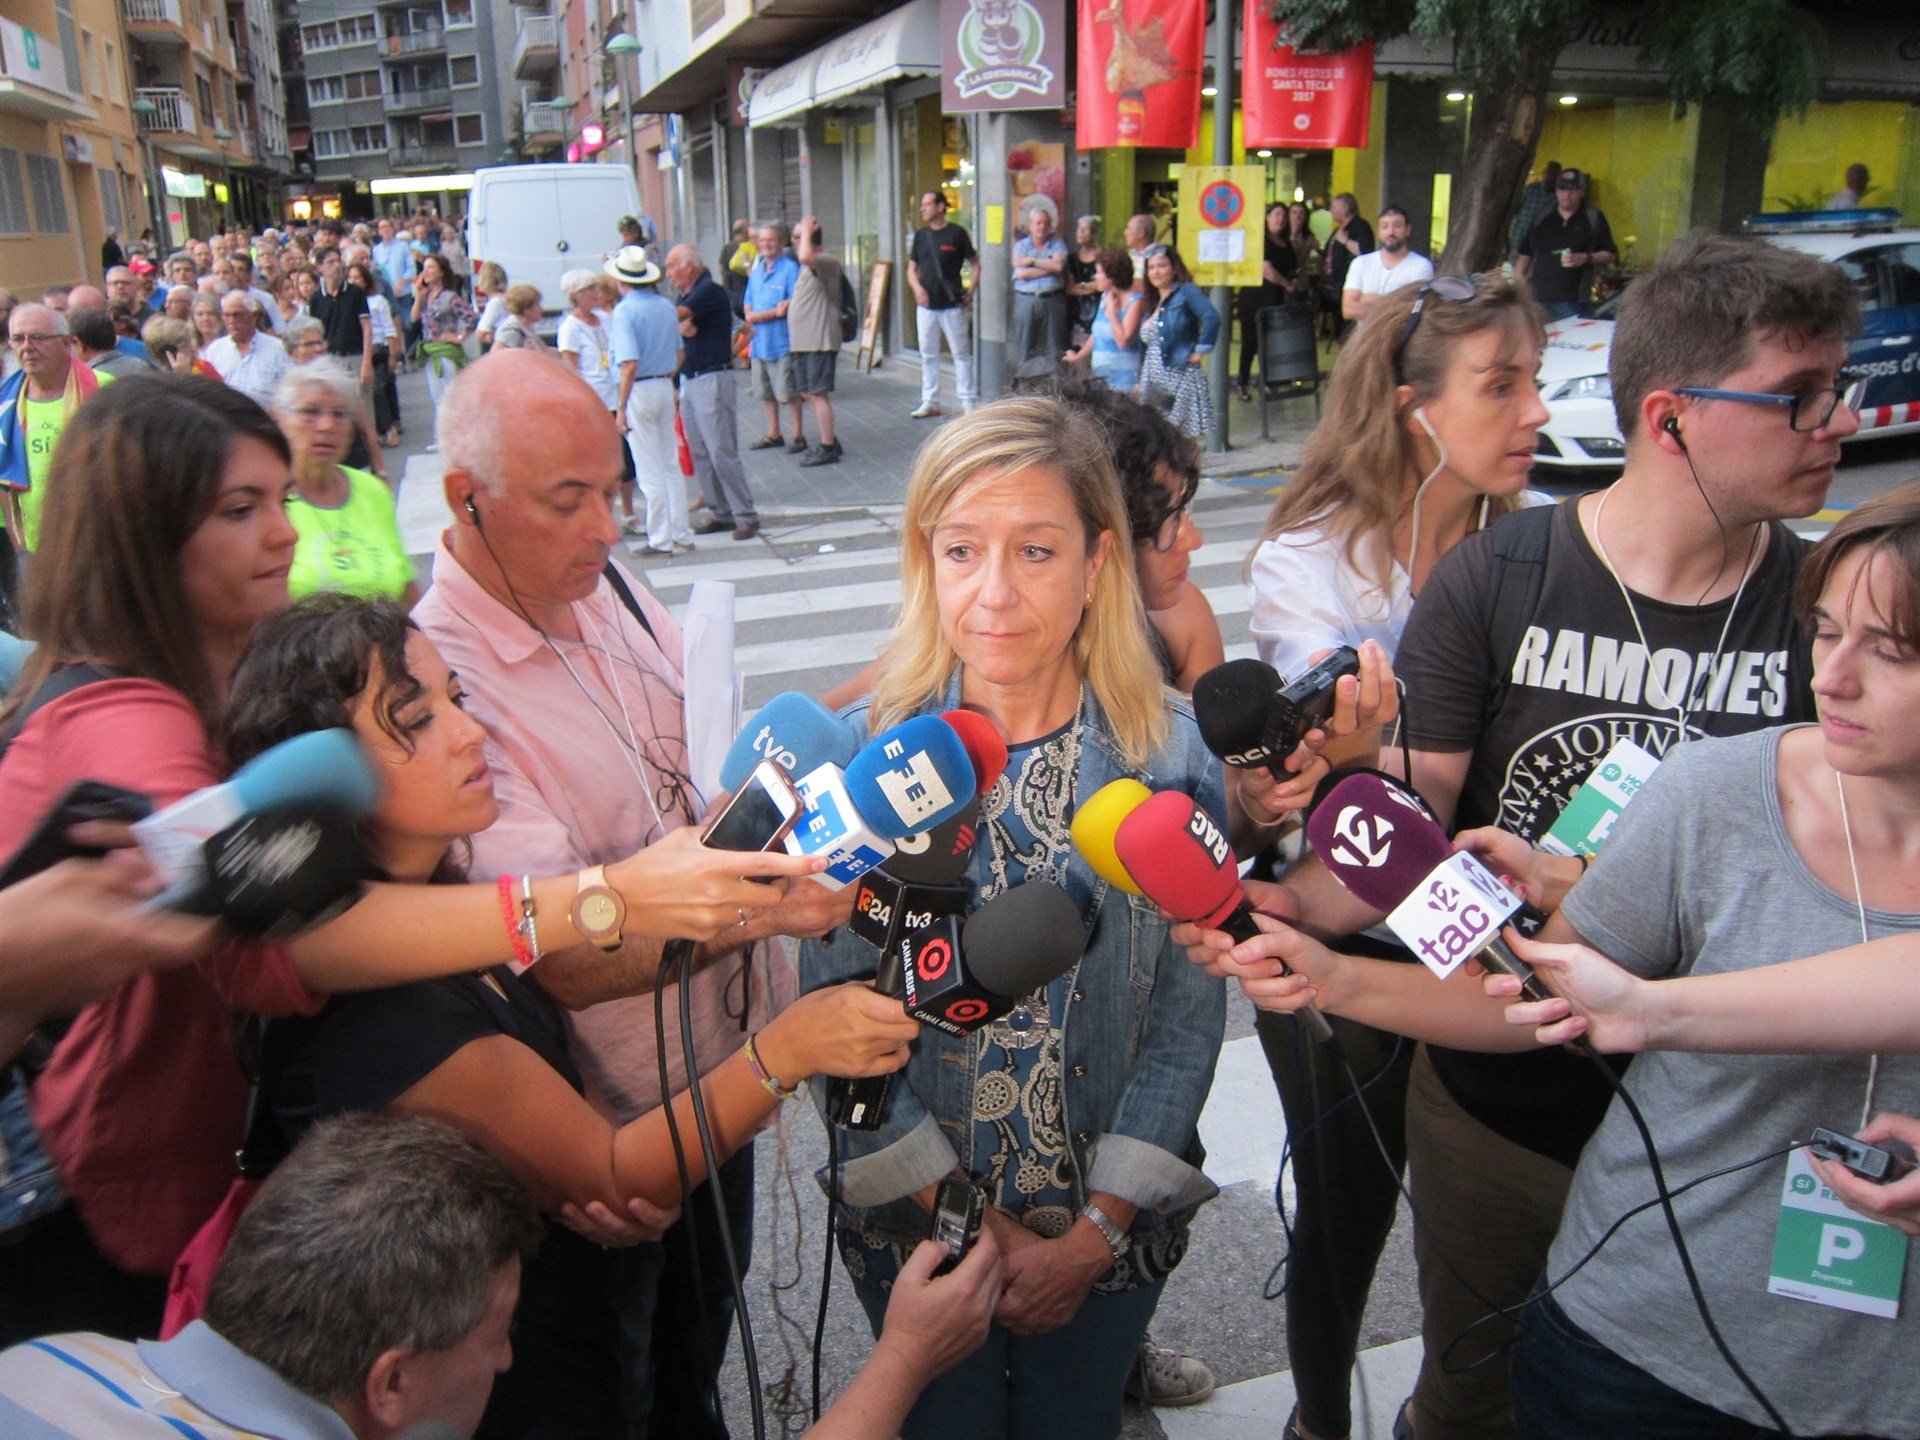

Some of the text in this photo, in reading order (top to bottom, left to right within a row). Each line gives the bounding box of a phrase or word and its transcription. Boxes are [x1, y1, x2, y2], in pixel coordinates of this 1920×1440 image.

[1272, 80, 1335, 91] SANTA TECLA
[1511, 625, 1789, 717] RAMONES
[904, 910, 933, 929] tv3
[1418, 904, 1490, 966] tac
[901, 938, 913, 972] CANAL
[914, 1010, 941, 1025] CANAL
[1816, 1222, 1866, 1268] P
